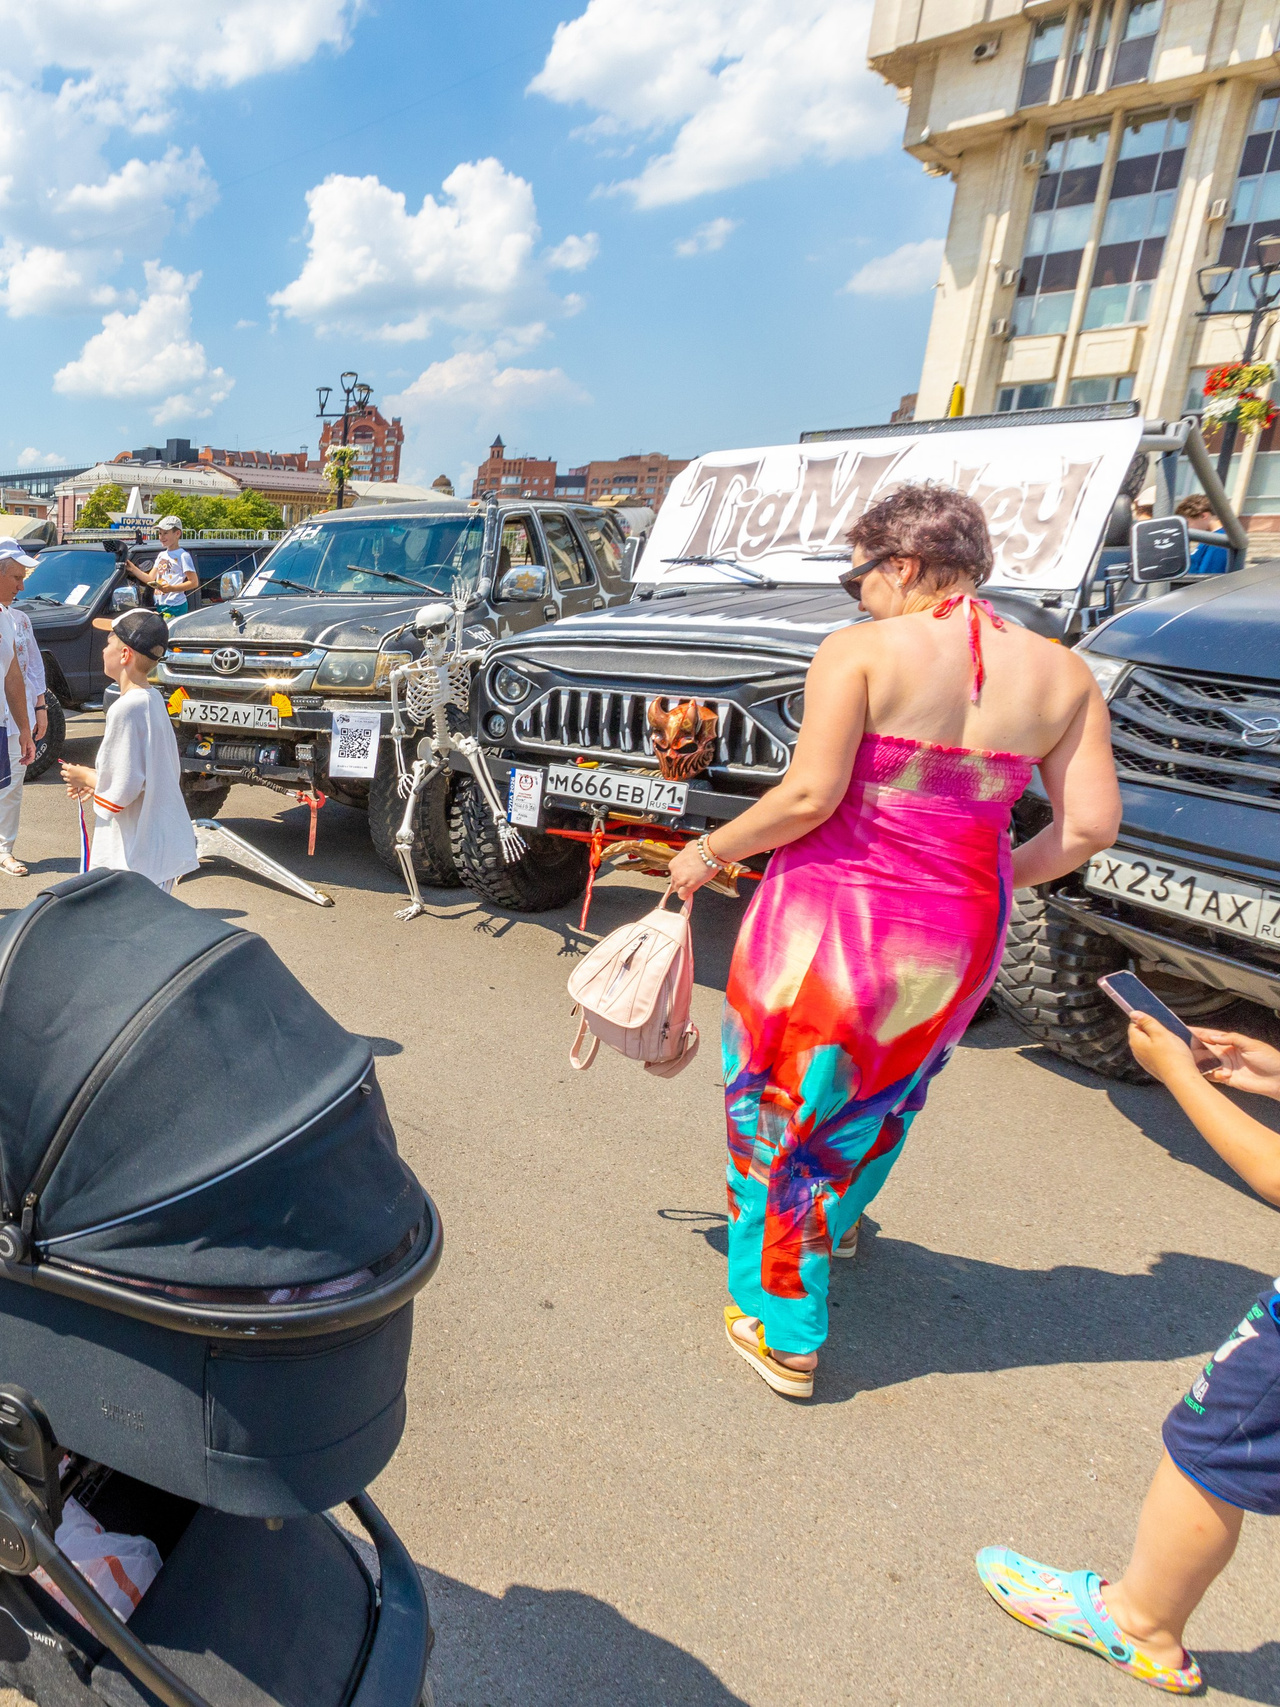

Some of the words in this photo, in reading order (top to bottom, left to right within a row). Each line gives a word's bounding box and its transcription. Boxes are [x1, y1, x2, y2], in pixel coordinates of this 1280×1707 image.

[257, 708, 273, 722] 71
[554, 773, 645, 804] М666ЕВ
[654, 783, 678, 804] 71
[649, 801, 668, 810] RUS
[1102, 860, 1253, 928] Х231АХ
[33, 1632, 56, 1648] SAFETY
